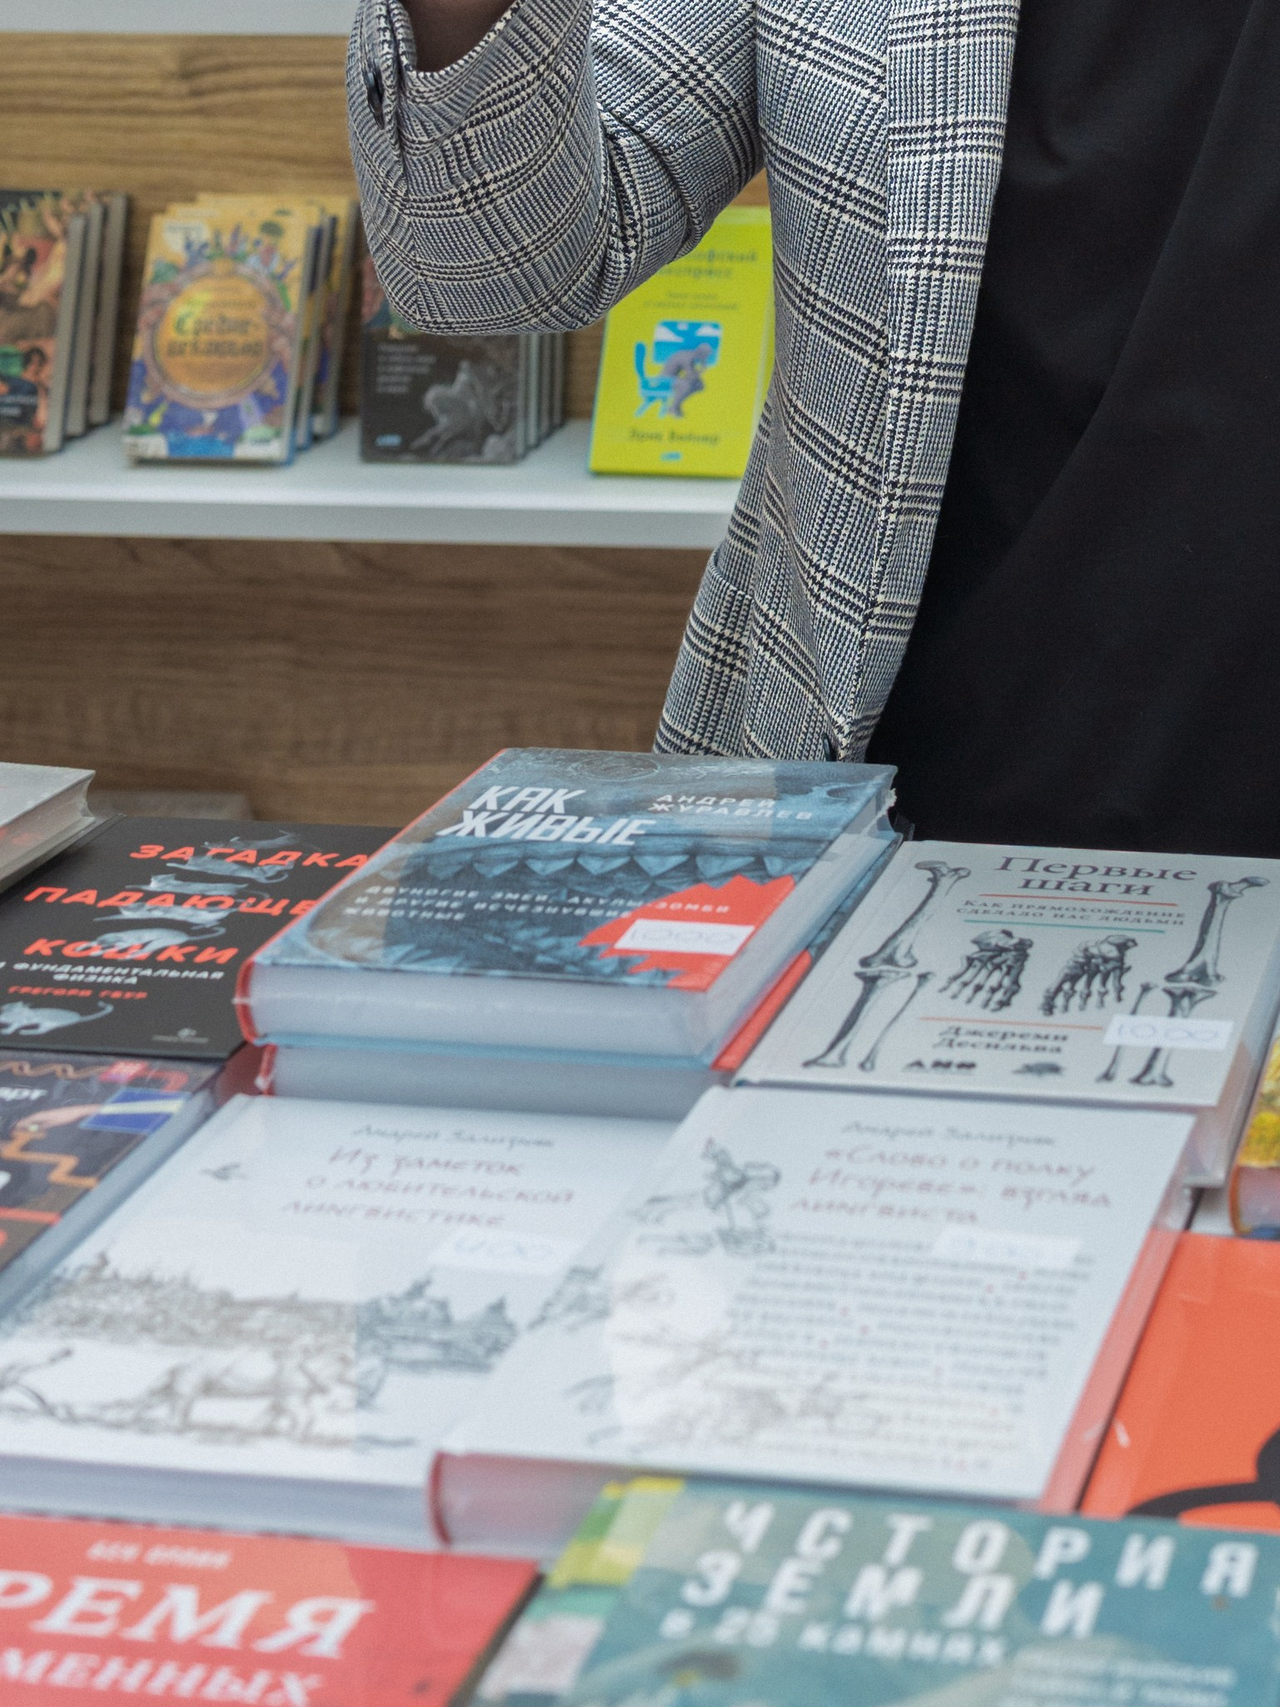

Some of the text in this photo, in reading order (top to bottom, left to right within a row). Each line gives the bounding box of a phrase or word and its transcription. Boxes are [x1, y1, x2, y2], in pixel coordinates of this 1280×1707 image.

[468, 785, 587, 815] КАК
[656, 793, 778, 809] АНДРЕЙ
[436, 809, 657, 847] ЖИВЫЕ
[129, 844, 372, 868] ЗАГАДКА
[994, 855, 1198, 881] Первые
[1017, 877, 1155, 896] шаги
[24, 886, 322, 916] ПАДАЮЩЕ
[376, 897, 463, 910] ДРУГИЕ
[342, 906, 466, 922] ЖИВОТНЫЕ
[1053, 912, 1091, 921] НАС
[23, 938, 239, 964] КОШКИ
[13, 962, 225, 980] ФУНДАМЕНТАЛЬНАЯ
[53, 972, 138, 985] ФИЗИКА
[679, 1549, 1105, 1639] ЗЕМЛИ
